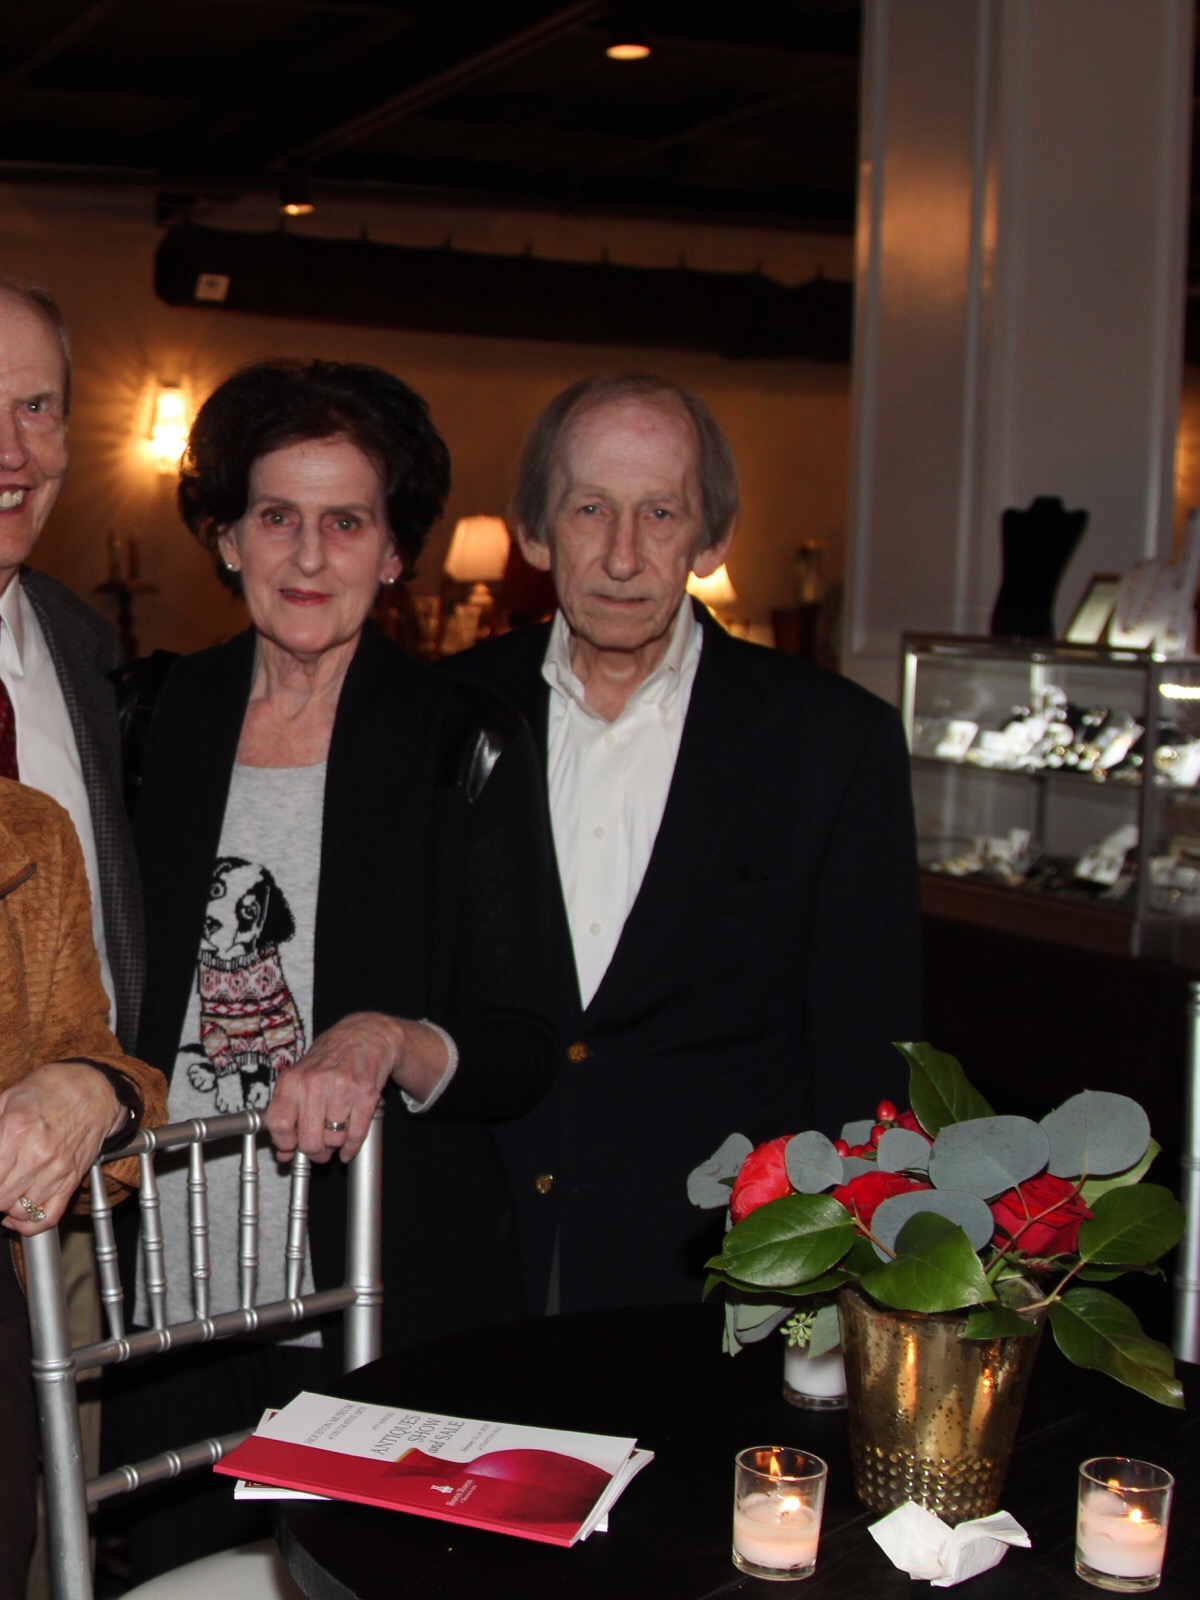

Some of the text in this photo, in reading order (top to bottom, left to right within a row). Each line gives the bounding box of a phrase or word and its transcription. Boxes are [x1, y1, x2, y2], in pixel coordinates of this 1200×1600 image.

[370, 1414, 421, 1455] ANTIQUES
[407, 1417, 442, 1442] SHOW
[427, 1420, 465, 1453] and SALE
